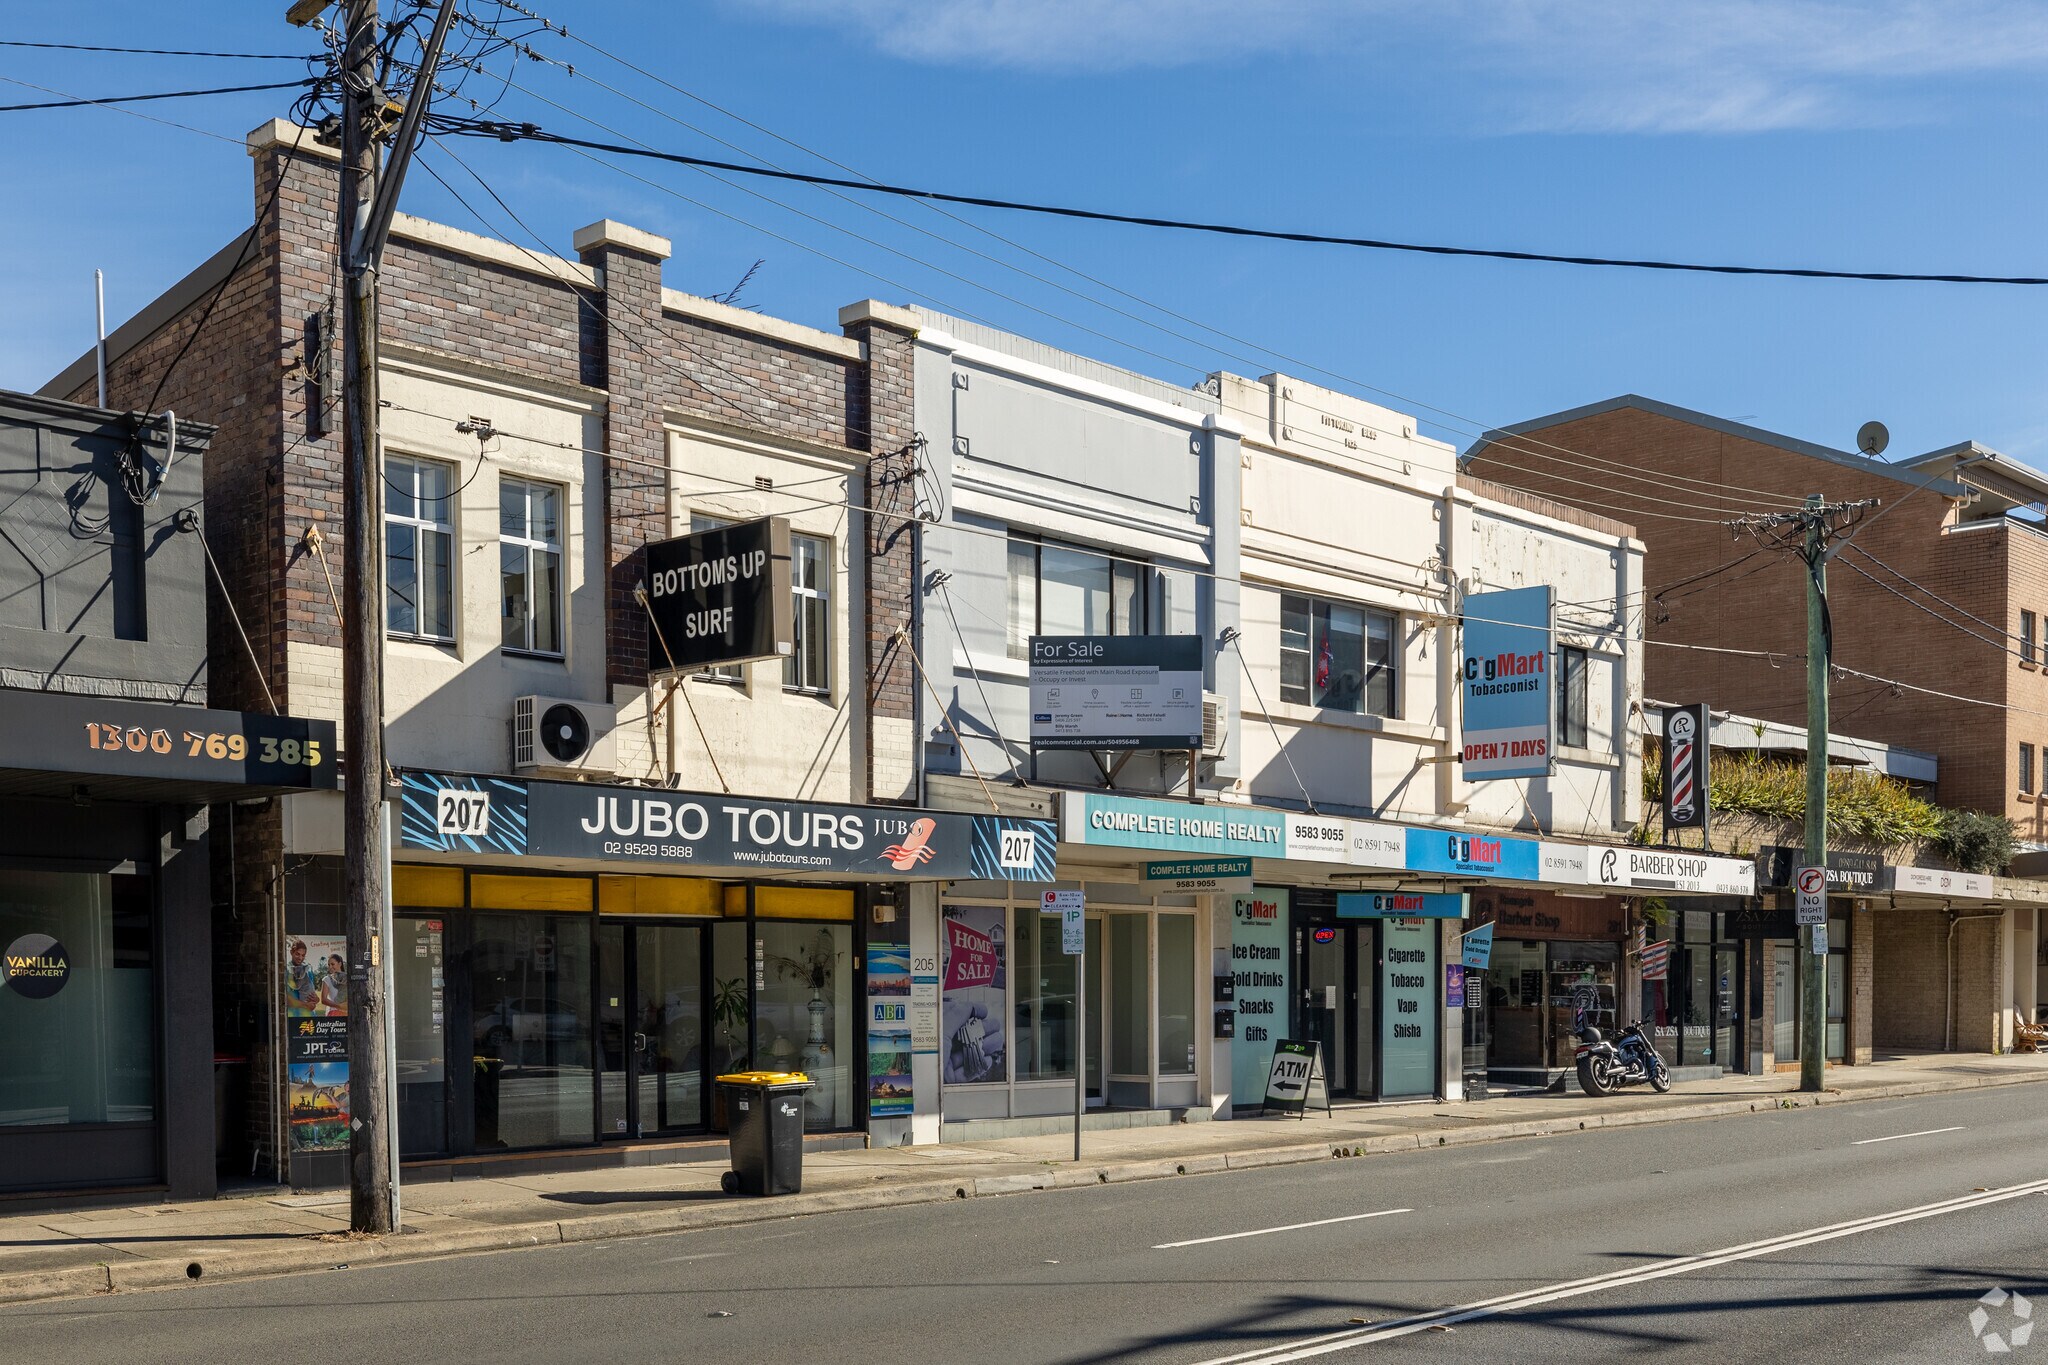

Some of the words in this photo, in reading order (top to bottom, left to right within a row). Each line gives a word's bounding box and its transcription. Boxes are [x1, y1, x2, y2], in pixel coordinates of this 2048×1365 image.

[653, 556, 738, 598] BOTTOMS
[742, 549, 766, 579] UP
[686, 606, 733, 639] SURF
[1035, 642, 1062, 657] For
[1068, 641, 1104, 657] Sale
[1465, 651, 1544, 681] CigMart
[1470, 678, 1538, 697] Tobacconist
[84, 722, 173, 755] 1300
[183, 730, 249, 761] 769
[259, 737, 322, 767] 385
[1464, 743, 1498, 761] OPEN
[1501, 742, 1508, 758] 7
[1511, 739, 1546, 758] DAYS
[442, 796, 487, 831] 207
[581, 796, 710, 841] JUBO
[722, 806, 864, 850] TOURS
[874, 818, 923, 837] JUBO
[1091, 810, 1176, 835] COMPLETE
[1179, 818, 1224, 840] HOME
[1226, 822, 1281, 844] REALTY
[1295, 825, 1319, 839] 9583
[1321, 828, 1344, 841] 9055
[604, 841, 622, 854] 02
[624, 843, 658, 856] 9529
[661, 845, 693, 858] 5888
[1004, 836, 1031, 862] 207
[1354, 838, 1363, 849] 02
[1364, 839, 1381, 851] 8591
[1384, 841, 1400, 852] 7948
[1447, 835, 1502, 863] CigMart
[733, 850, 831, 866] www.jubotours.com
[1545, 857, 1552, 868] 02
[1553, 858, 1567, 869] 8591
[1569, 859, 1583, 870] 7948
[1630, 854, 1674, 875] BARBER
[1675, 858, 1707, 878] SHOP
[1151, 865, 1190, 875] COMPLETE
[1192, 864, 1215, 873] HOME
[1217, 863, 1247, 872] REALTY
[1456, 863, 1474, 871] Specialist
[1474, 864, 1494, 872] Tobacconist
[1676, 880, 1685, 890] EST
[1686, 881, 1700, 890] 2013
[1826, 870, 1838, 882] ZSA
[1840, 871, 1873, 885] BOUTIQUE
[1047, 892, 1054, 902] C
[1374, 895, 1425, 910] CigMart
[1803, 897, 1820, 905] NO
[1066, 911, 1080, 922] 1P
[1535, 912, 1560, 930] Shop
[954, 929, 992, 955] HOME
[970, 953, 983, 963] FOR
[1232, 944, 1247, 959] Ice
[1249, 944, 1280, 960] Cream
[1388, 947, 1426, 964] Cigarette
[7, 956, 67, 968] VANILLA
[914, 958, 934, 971] 205
[10, 969, 65, 977] CUPCAKERY
[957, 962, 991, 981] SALE
[1253, 971, 1283, 987] Drinks
[1391, 973, 1425, 988] Tobacco
[875, 1005, 905, 1019] ABT
[1239, 998, 1274, 1014] Snacks
[1397, 998, 1418, 1014] Vape
[316, 1020, 346, 1028] Australian
[316, 1027, 329, 1035] Day
[1393, 1023, 1421, 1039] Shisha
[1683, 1025, 1710, 1038] BOUTIQUE
[1245, 1025, 1268, 1041] Gifts
[303, 1042, 327, 1055] JPT
[1274, 1060, 1308, 1078] ATM
